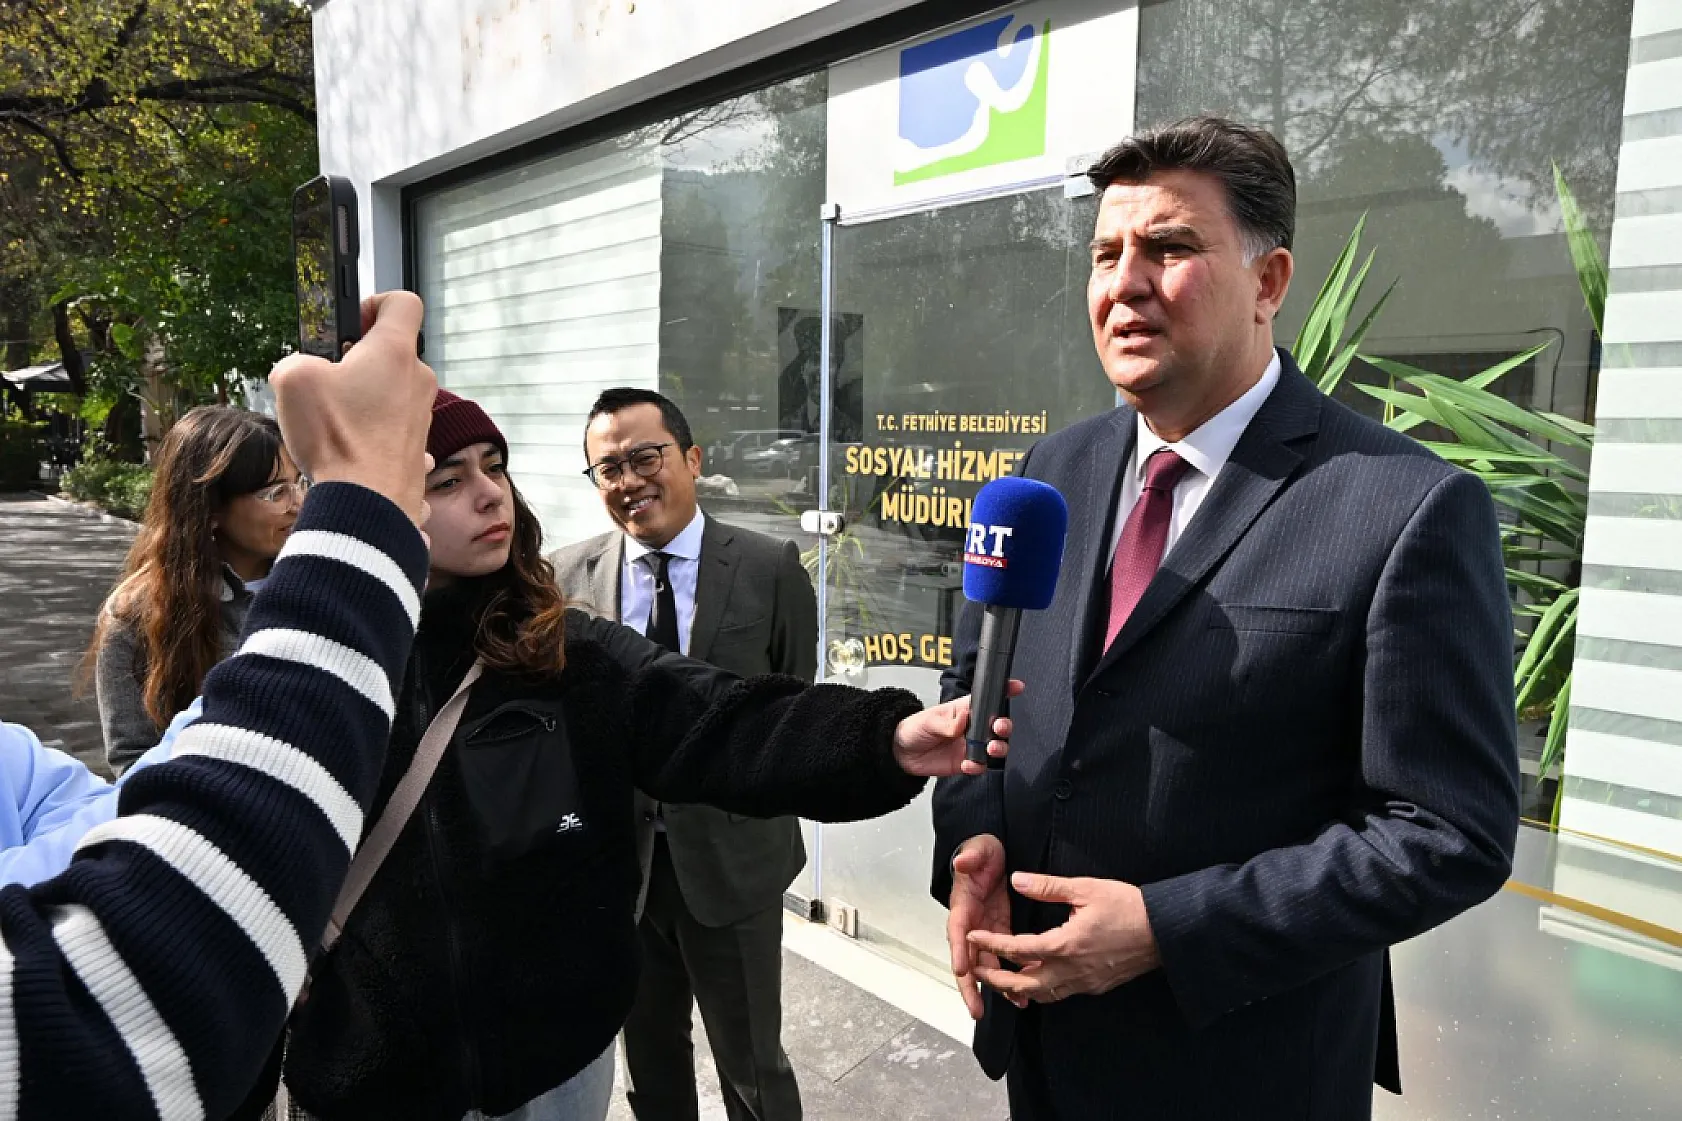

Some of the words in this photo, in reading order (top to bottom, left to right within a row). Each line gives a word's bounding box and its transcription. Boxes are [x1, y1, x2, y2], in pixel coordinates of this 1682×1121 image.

[876, 414, 899, 431] T.C.
[902, 410, 957, 432] FETHİYE
[959, 410, 1047, 434] BELEDİYESİ
[845, 445, 931, 479] SOSYAL
[965, 521, 1013, 558] RT
[864, 632, 913, 664] HOŞ
